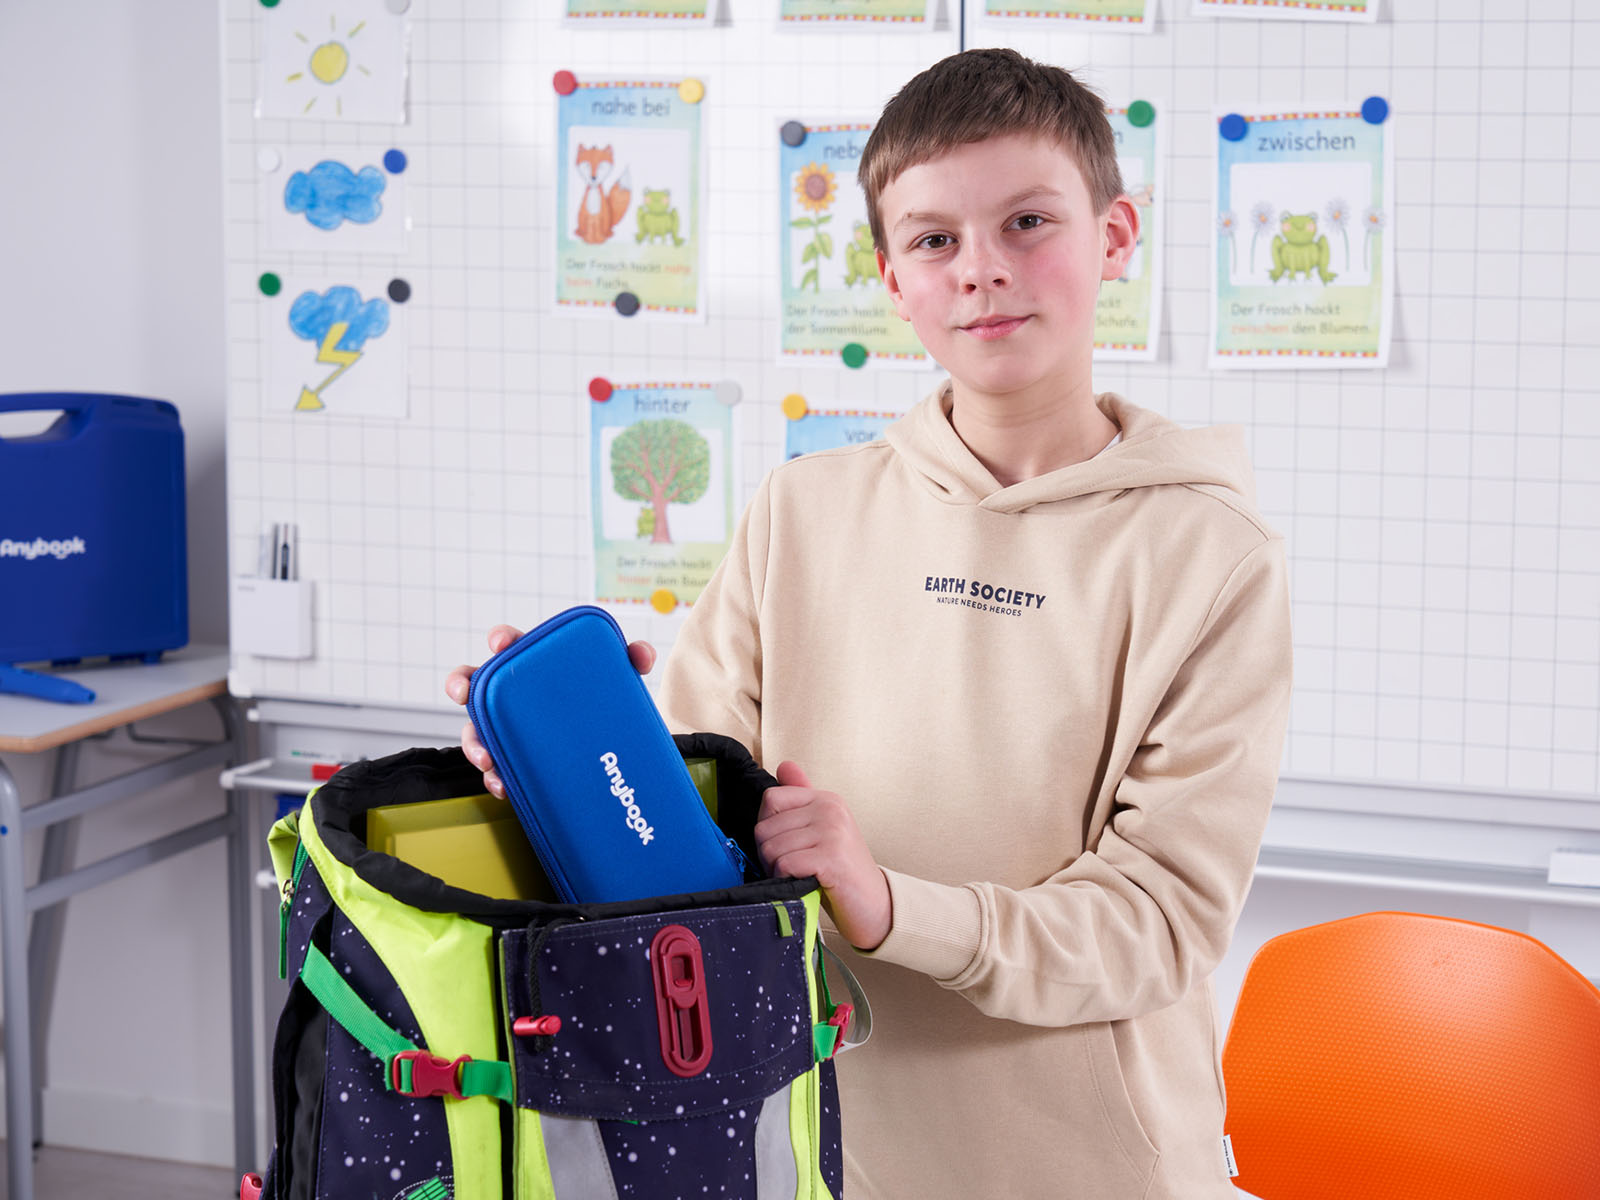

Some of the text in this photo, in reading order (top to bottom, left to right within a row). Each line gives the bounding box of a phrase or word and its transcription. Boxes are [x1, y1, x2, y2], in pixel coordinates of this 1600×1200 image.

[591, 97, 671, 116] nahe bei
[1257, 130, 1356, 152] zwischen
[1230, 303, 1341, 317] Der Frosch hockt
[633, 394, 691, 415] hinter
[844, 431, 878, 445] vor
[0, 536, 86, 560] Anybook
[924, 576, 1047, 609] EARTH SOCIETY
[936, 596, 1023, 617] NATURE NEEDS HEROES
[600, 751, 655, 846] Anybook
